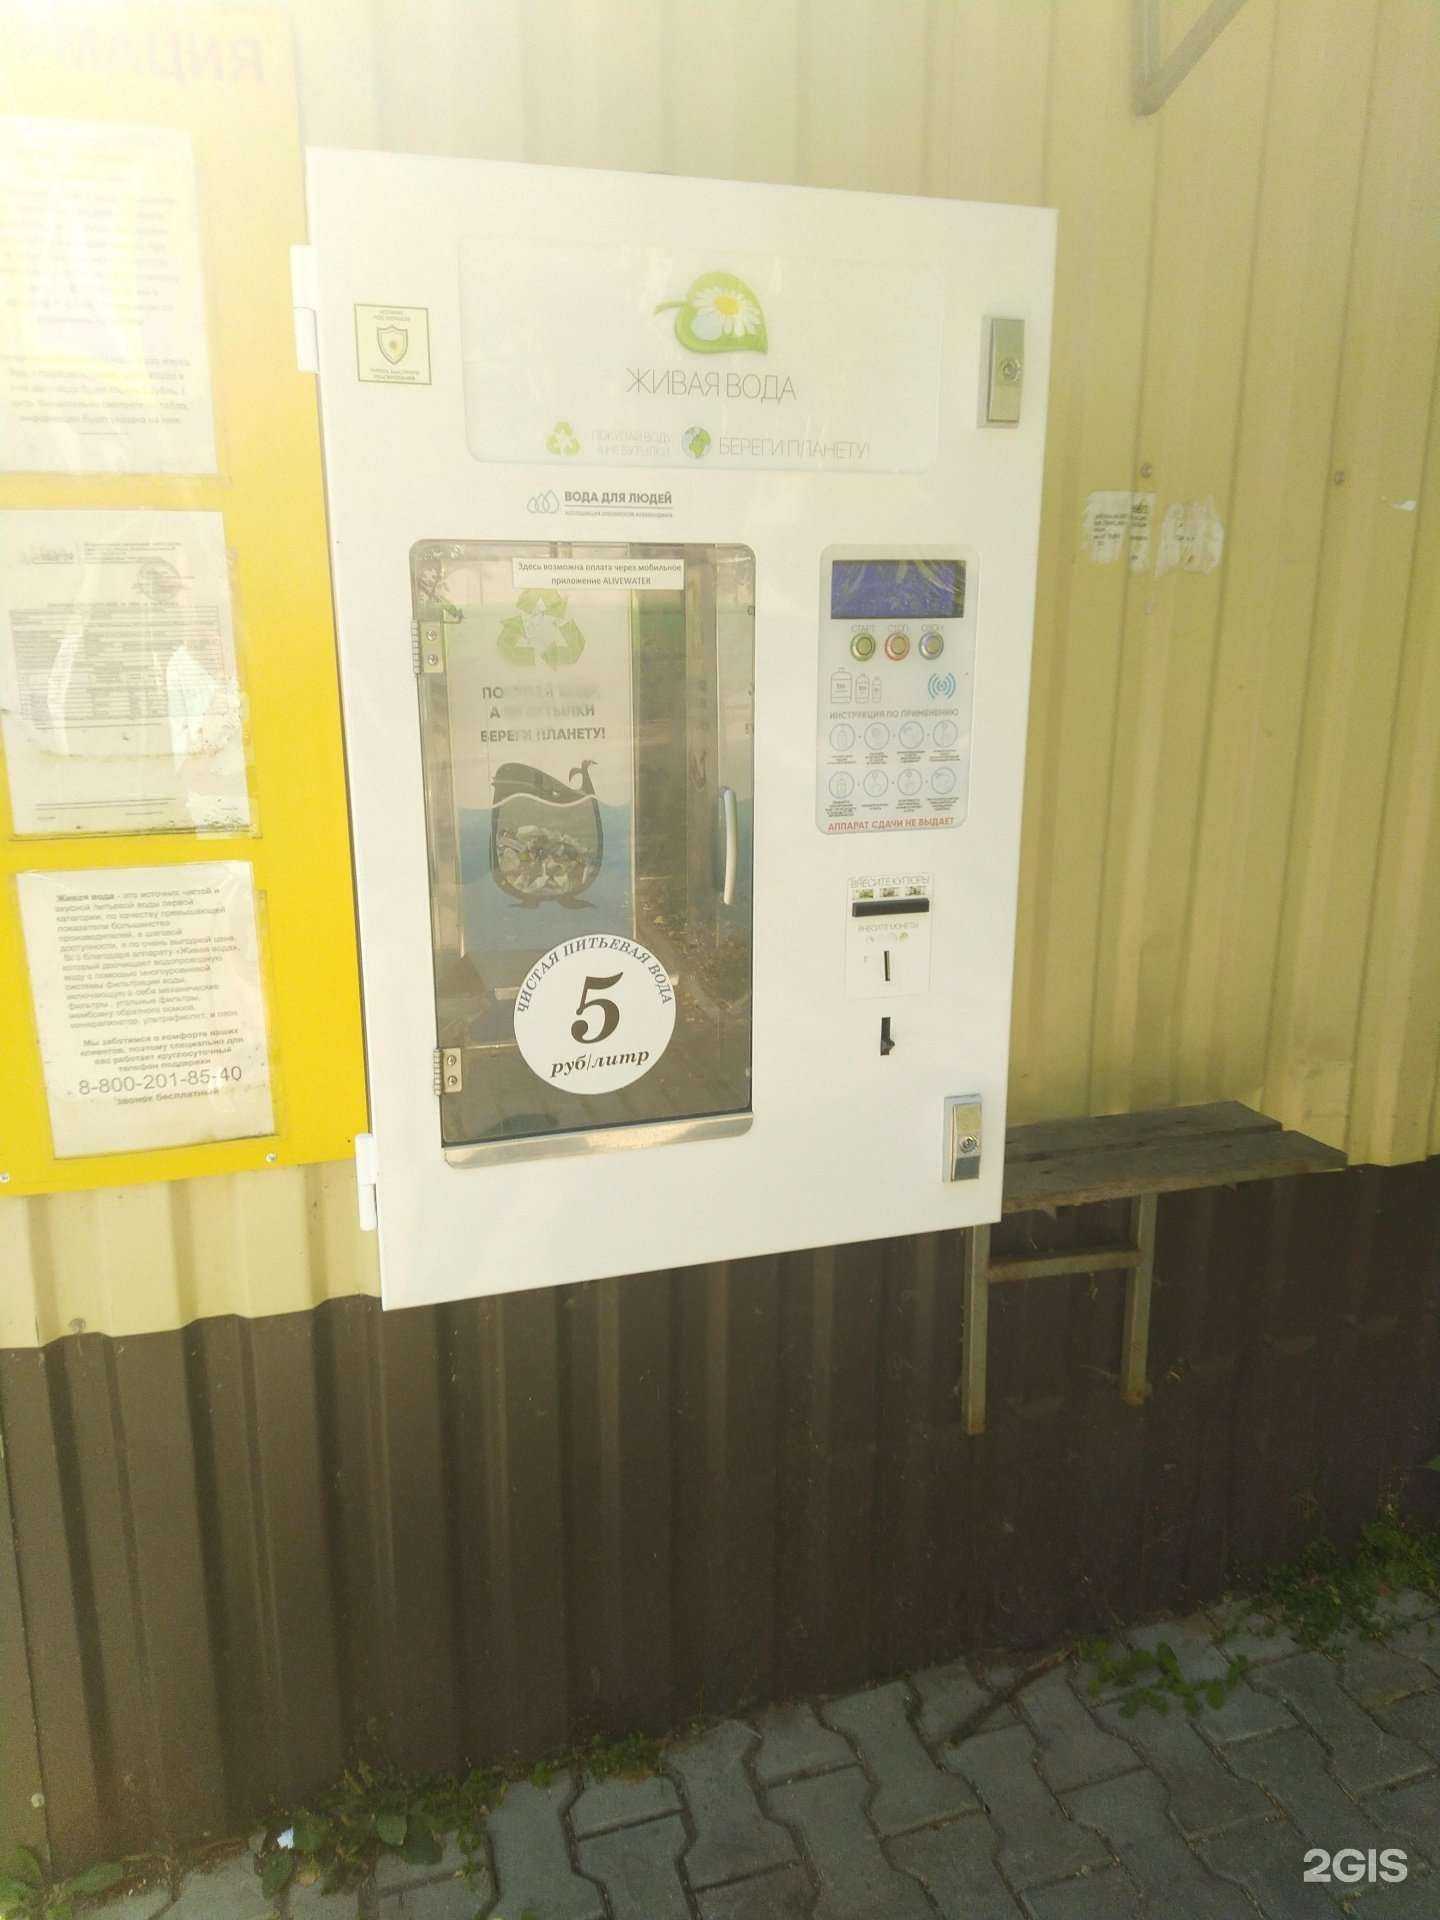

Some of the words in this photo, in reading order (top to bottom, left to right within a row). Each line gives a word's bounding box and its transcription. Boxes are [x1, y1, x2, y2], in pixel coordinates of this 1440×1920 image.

[626, 367, 720, 398] ЖИВАЯ
[725, 372, 798, 405] ВОДА
[719, 436, 784, 457] БЕРЕГИ
[564, 491, 598, 504] ВОДА
[601, 492, 626, 505] ДЛЯ
[628, 491, 673, 505] ЛЮДЕЙ
[518, 562, 542, 572] Здесь
[543, 562, 584, 572] возможна
[585, 563, 613, 572] оплата
[614, 563, 637, 573] через
[638, 562, 682, 572] мобильное
[551, 577, 601, 587] приложение
[602, 576, 652, 586] ALIVEWATER
[828, 821, 870, 833] АППАРАТ
[872, 819, 904, 830] СДАЧИ
[905, 819, 917, 828] НЕ
[919, 816, 955, 827] ВЫДАЕТ
[517, 951, 560, 1013] ЧИСТАЯ
[563, 936, 651, 964] ПИТЬЕВАЯ
[648, 963, 673, 1004] ВОДА
[571, 971, 624, 1044] 5
[550, 1050, 650, 1079] руб/литр
[78, 1065, 243, 1096] 8-800-201-85-40
